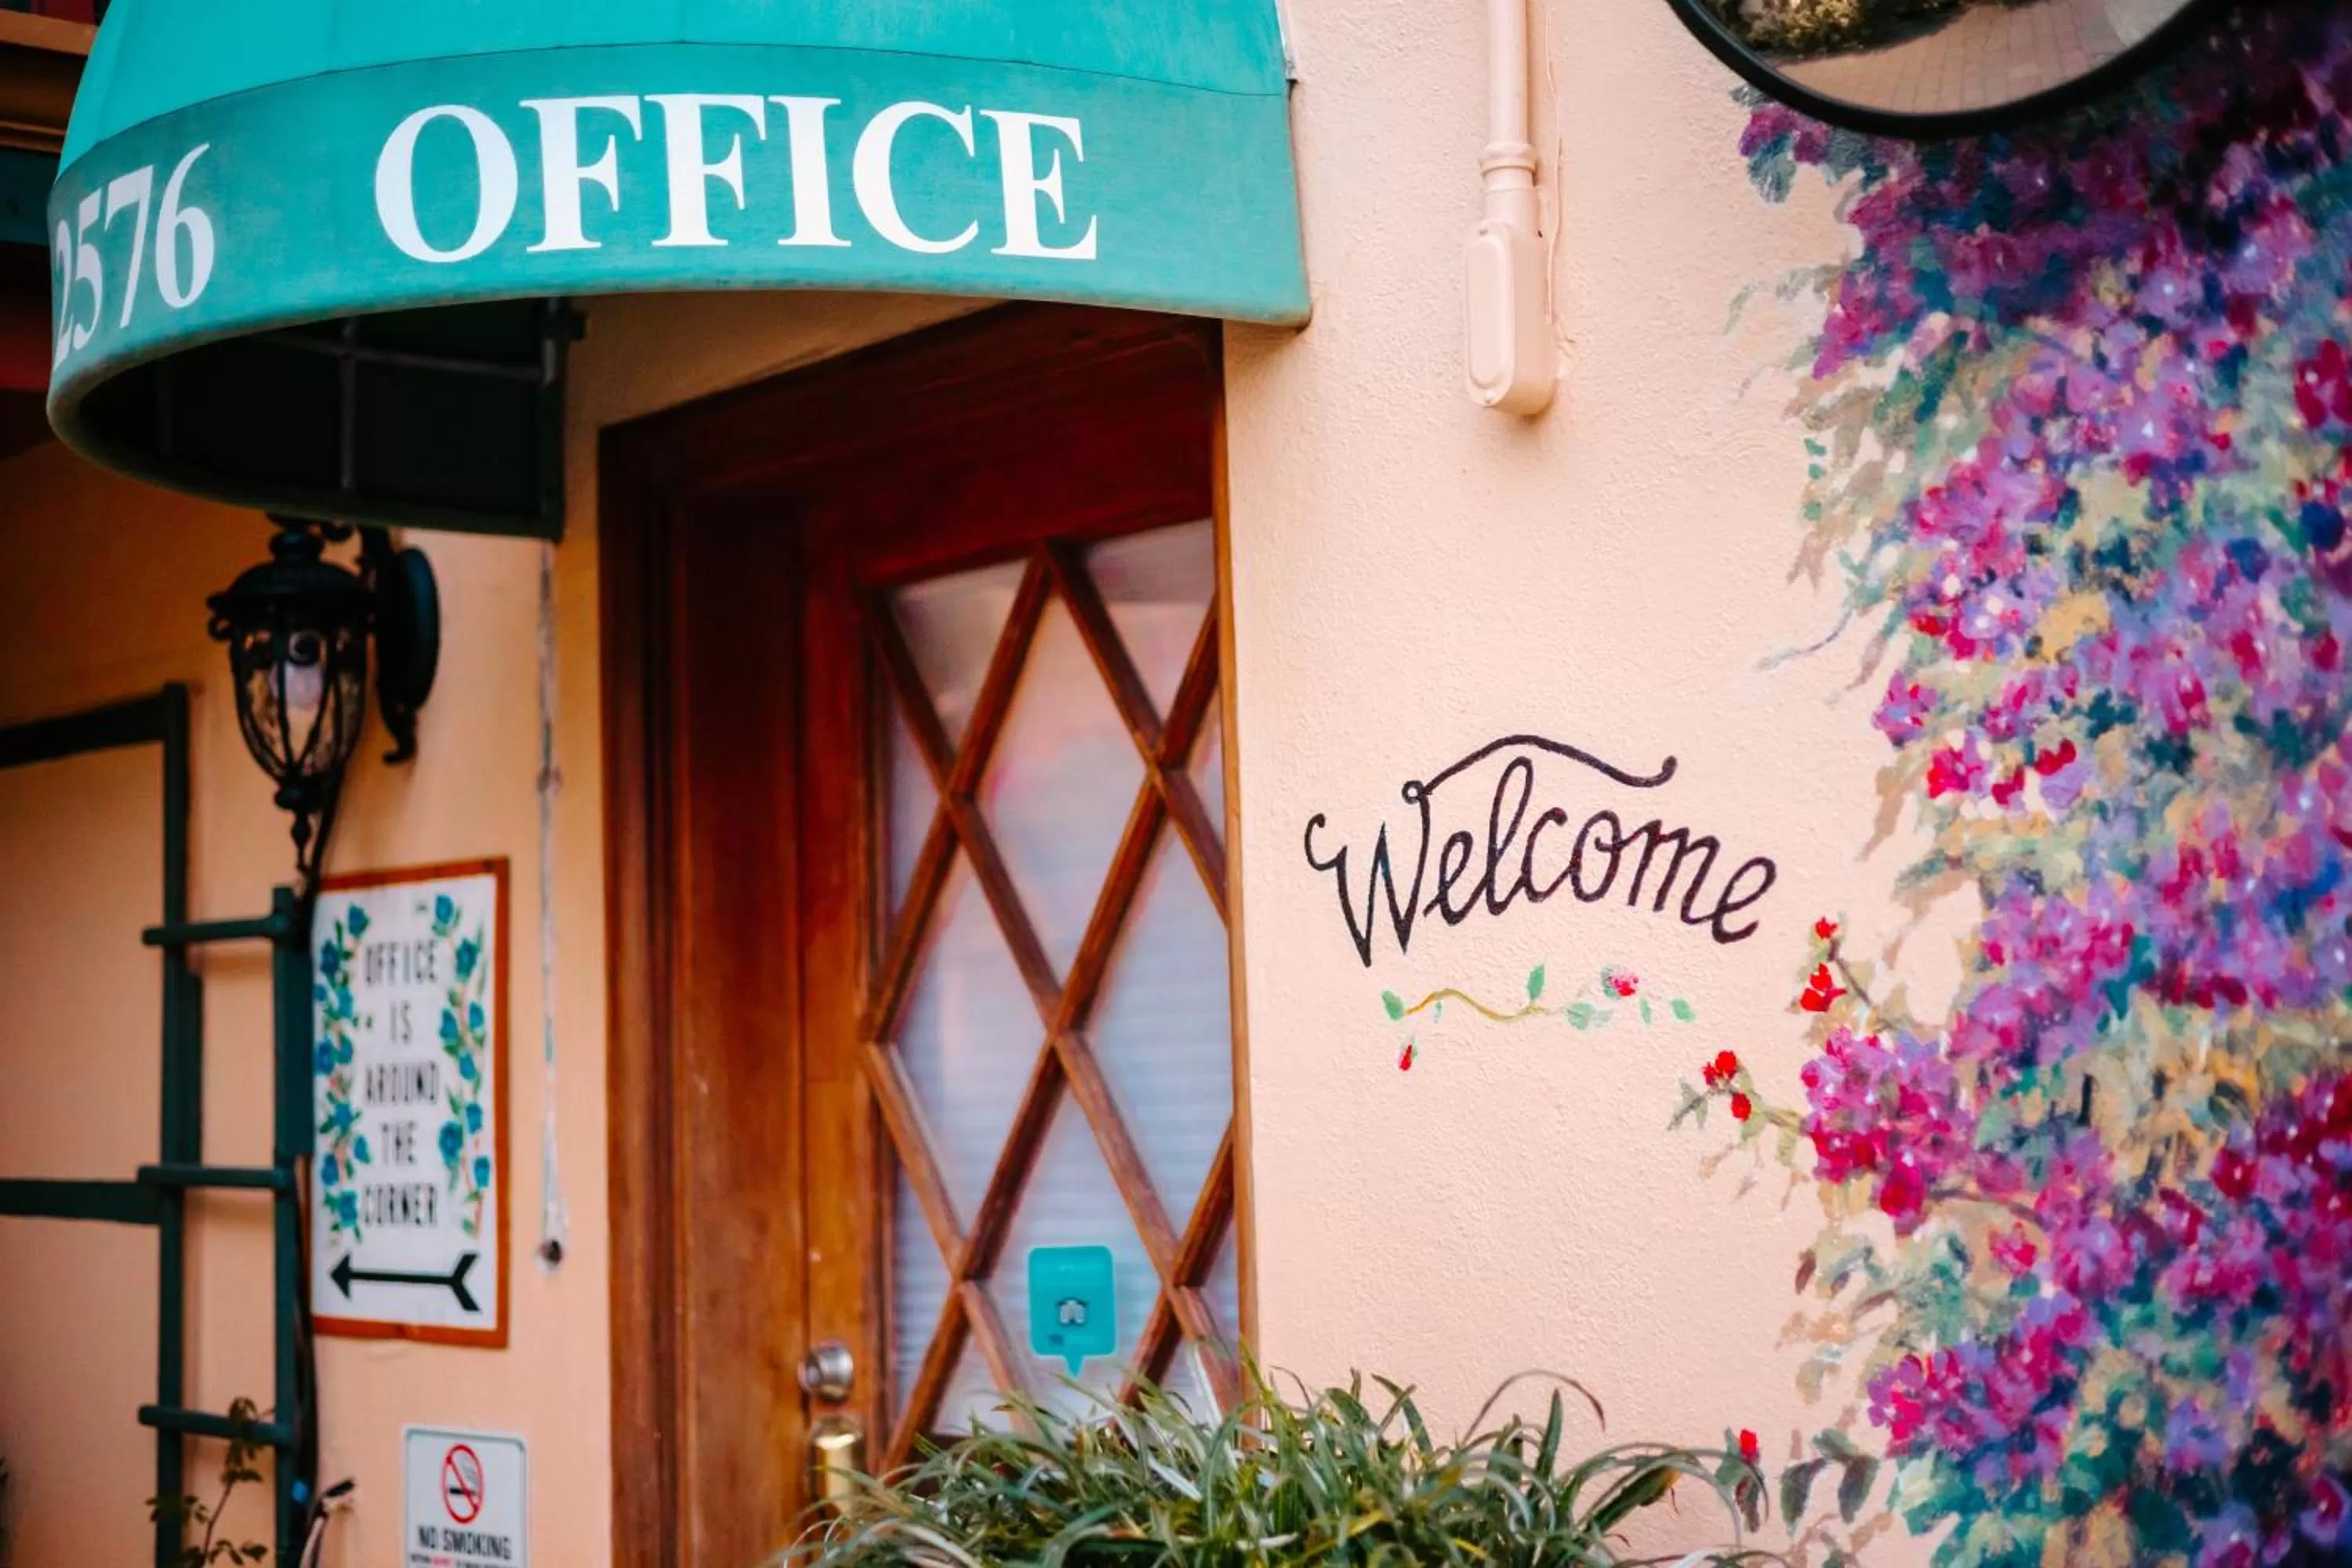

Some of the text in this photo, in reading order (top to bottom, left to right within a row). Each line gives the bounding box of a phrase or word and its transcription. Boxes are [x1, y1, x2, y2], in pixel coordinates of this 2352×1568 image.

[374, 93, 1098, 263] OFFICE
[52, 142, 215, 374] 2576
[1305, 734, 1777, 968] Welcome
[365, 940, 439, 985] OFFICE
[389, 1000, 412, 1045] IS
[364, 1062, 439, 1105] AROUND
[380, 1119, 417, 1167] THE
[361, 1182, 438, 1228] CORNER
[417, 1525, 512, 1560] NO SMOKING
